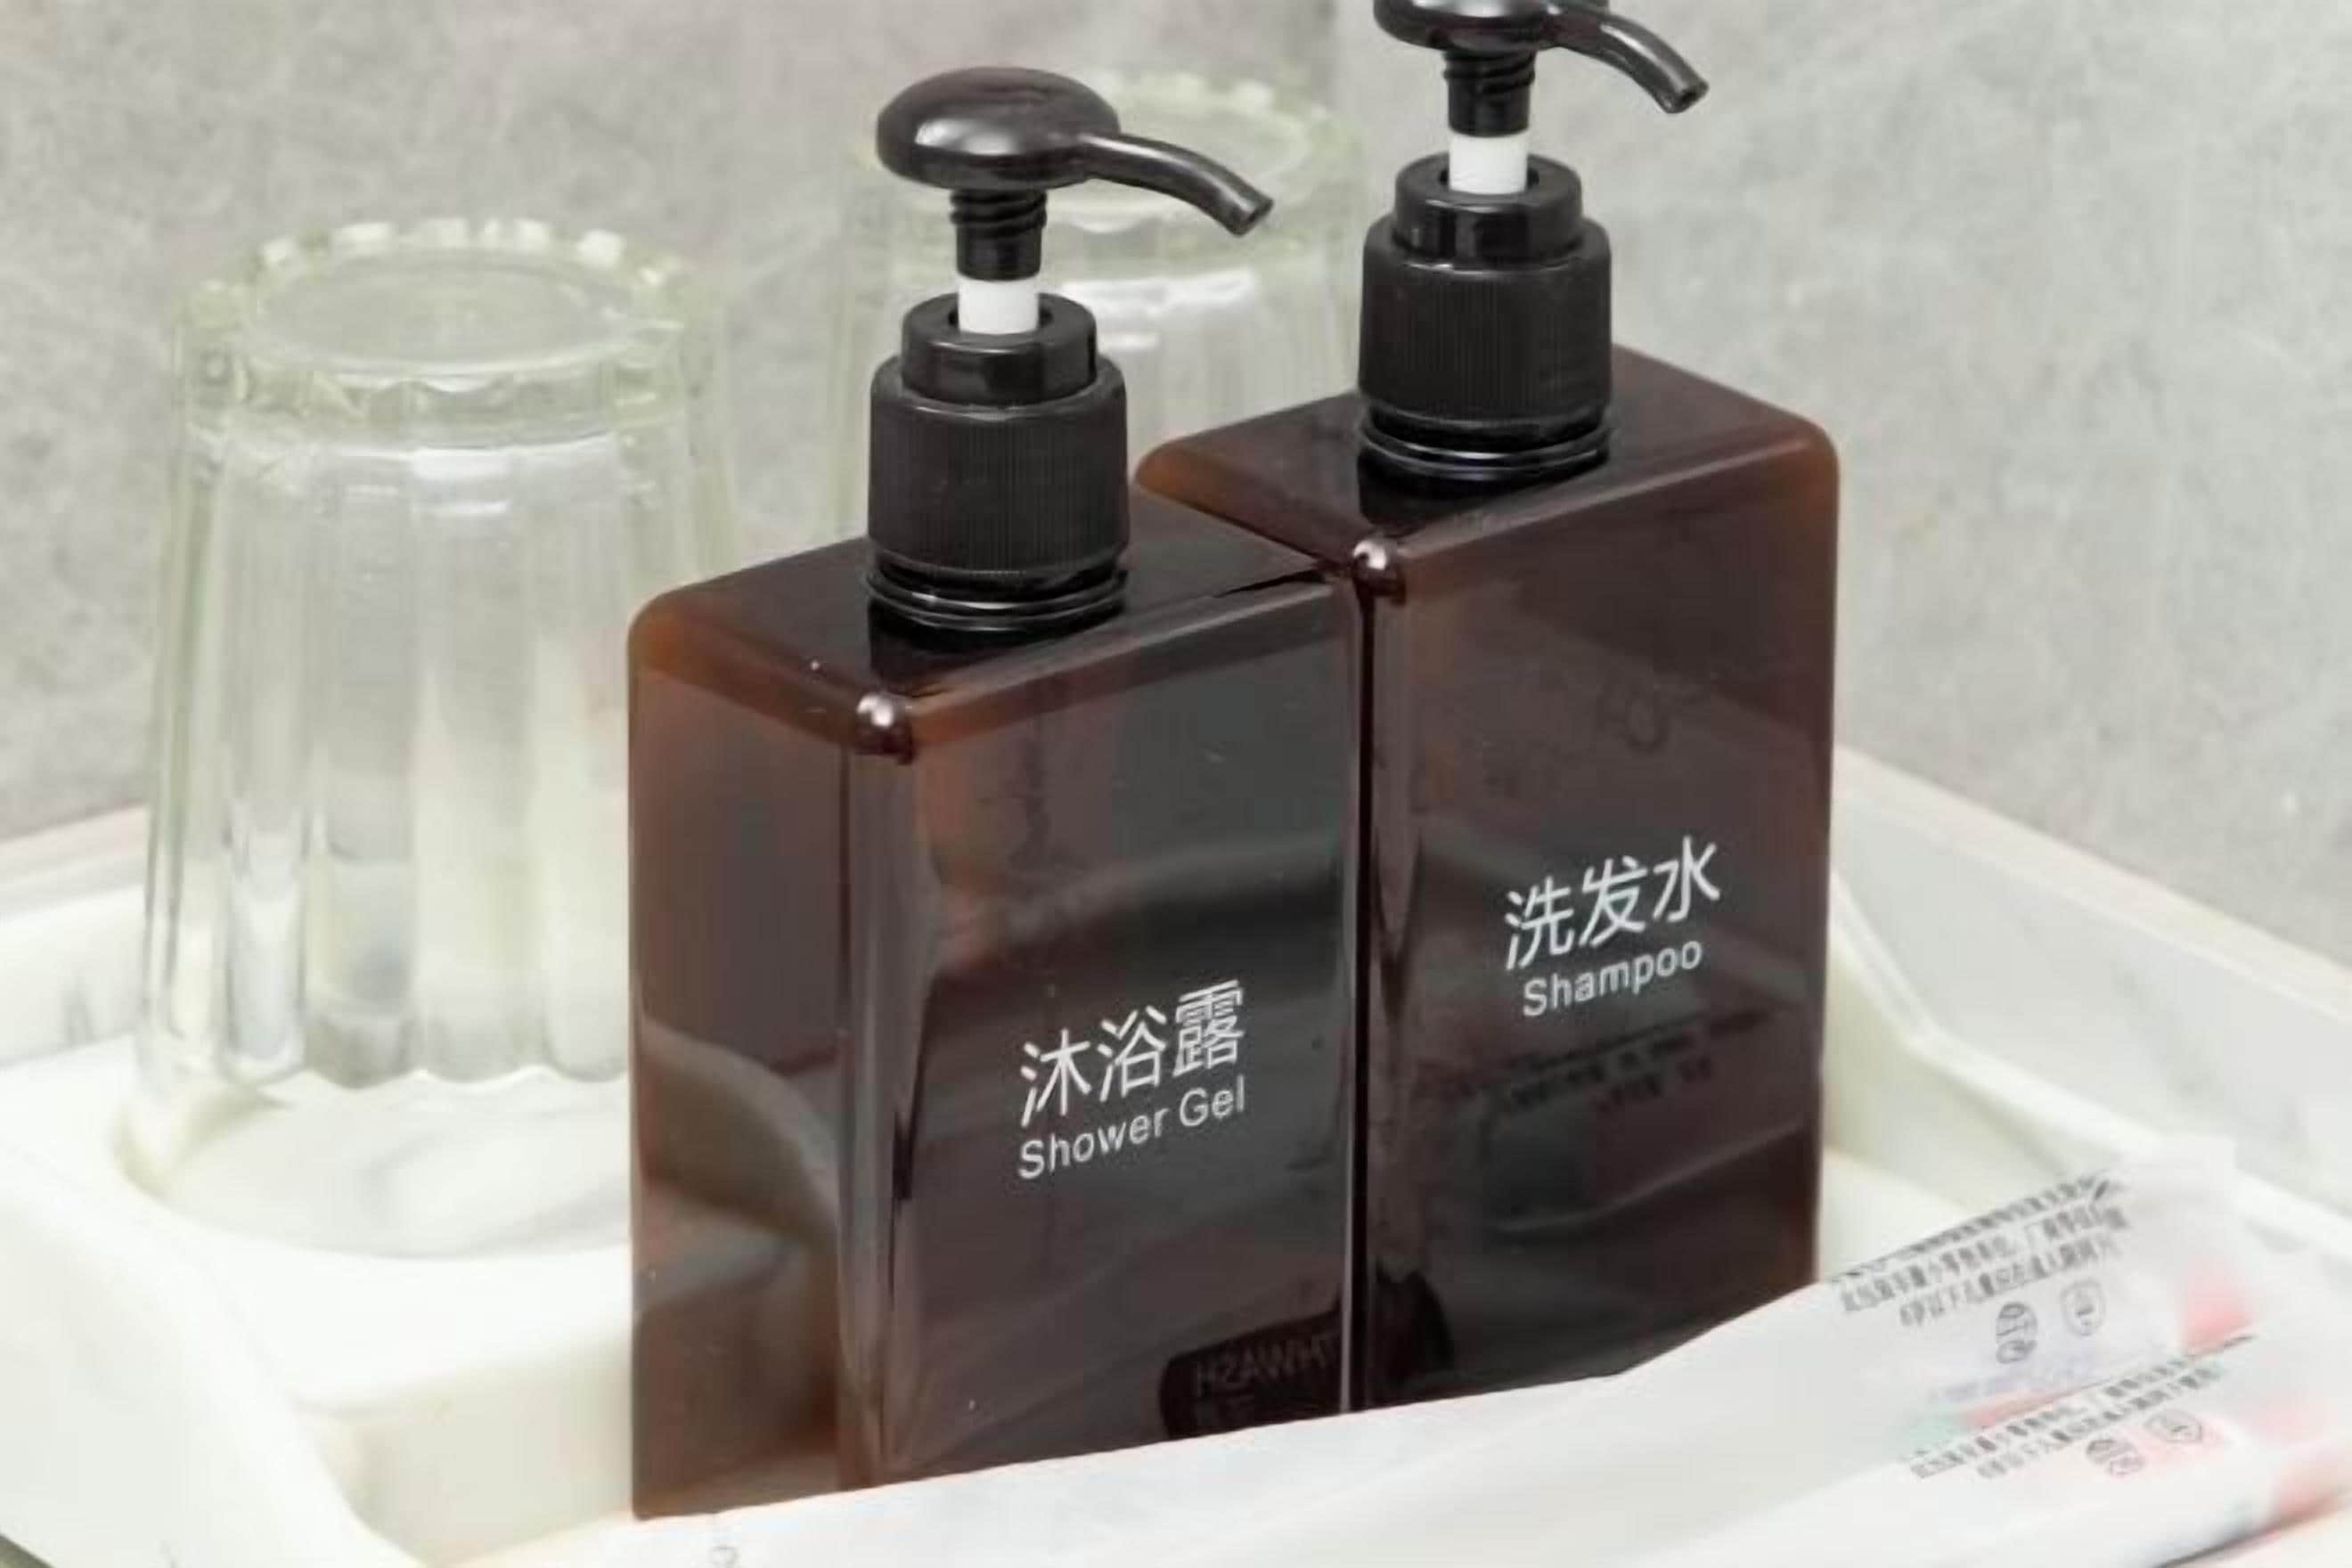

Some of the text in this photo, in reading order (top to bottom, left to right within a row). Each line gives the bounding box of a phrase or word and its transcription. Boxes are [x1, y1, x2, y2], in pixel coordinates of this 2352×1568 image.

[1506, 836, 1720, 971] 洗发水
[1523, 941, 1703, 1017] Shampoo
[1021, 979, 1245, 1127] 沐浴露
[1019, 1074, 1245, 1180] Shower Gel
